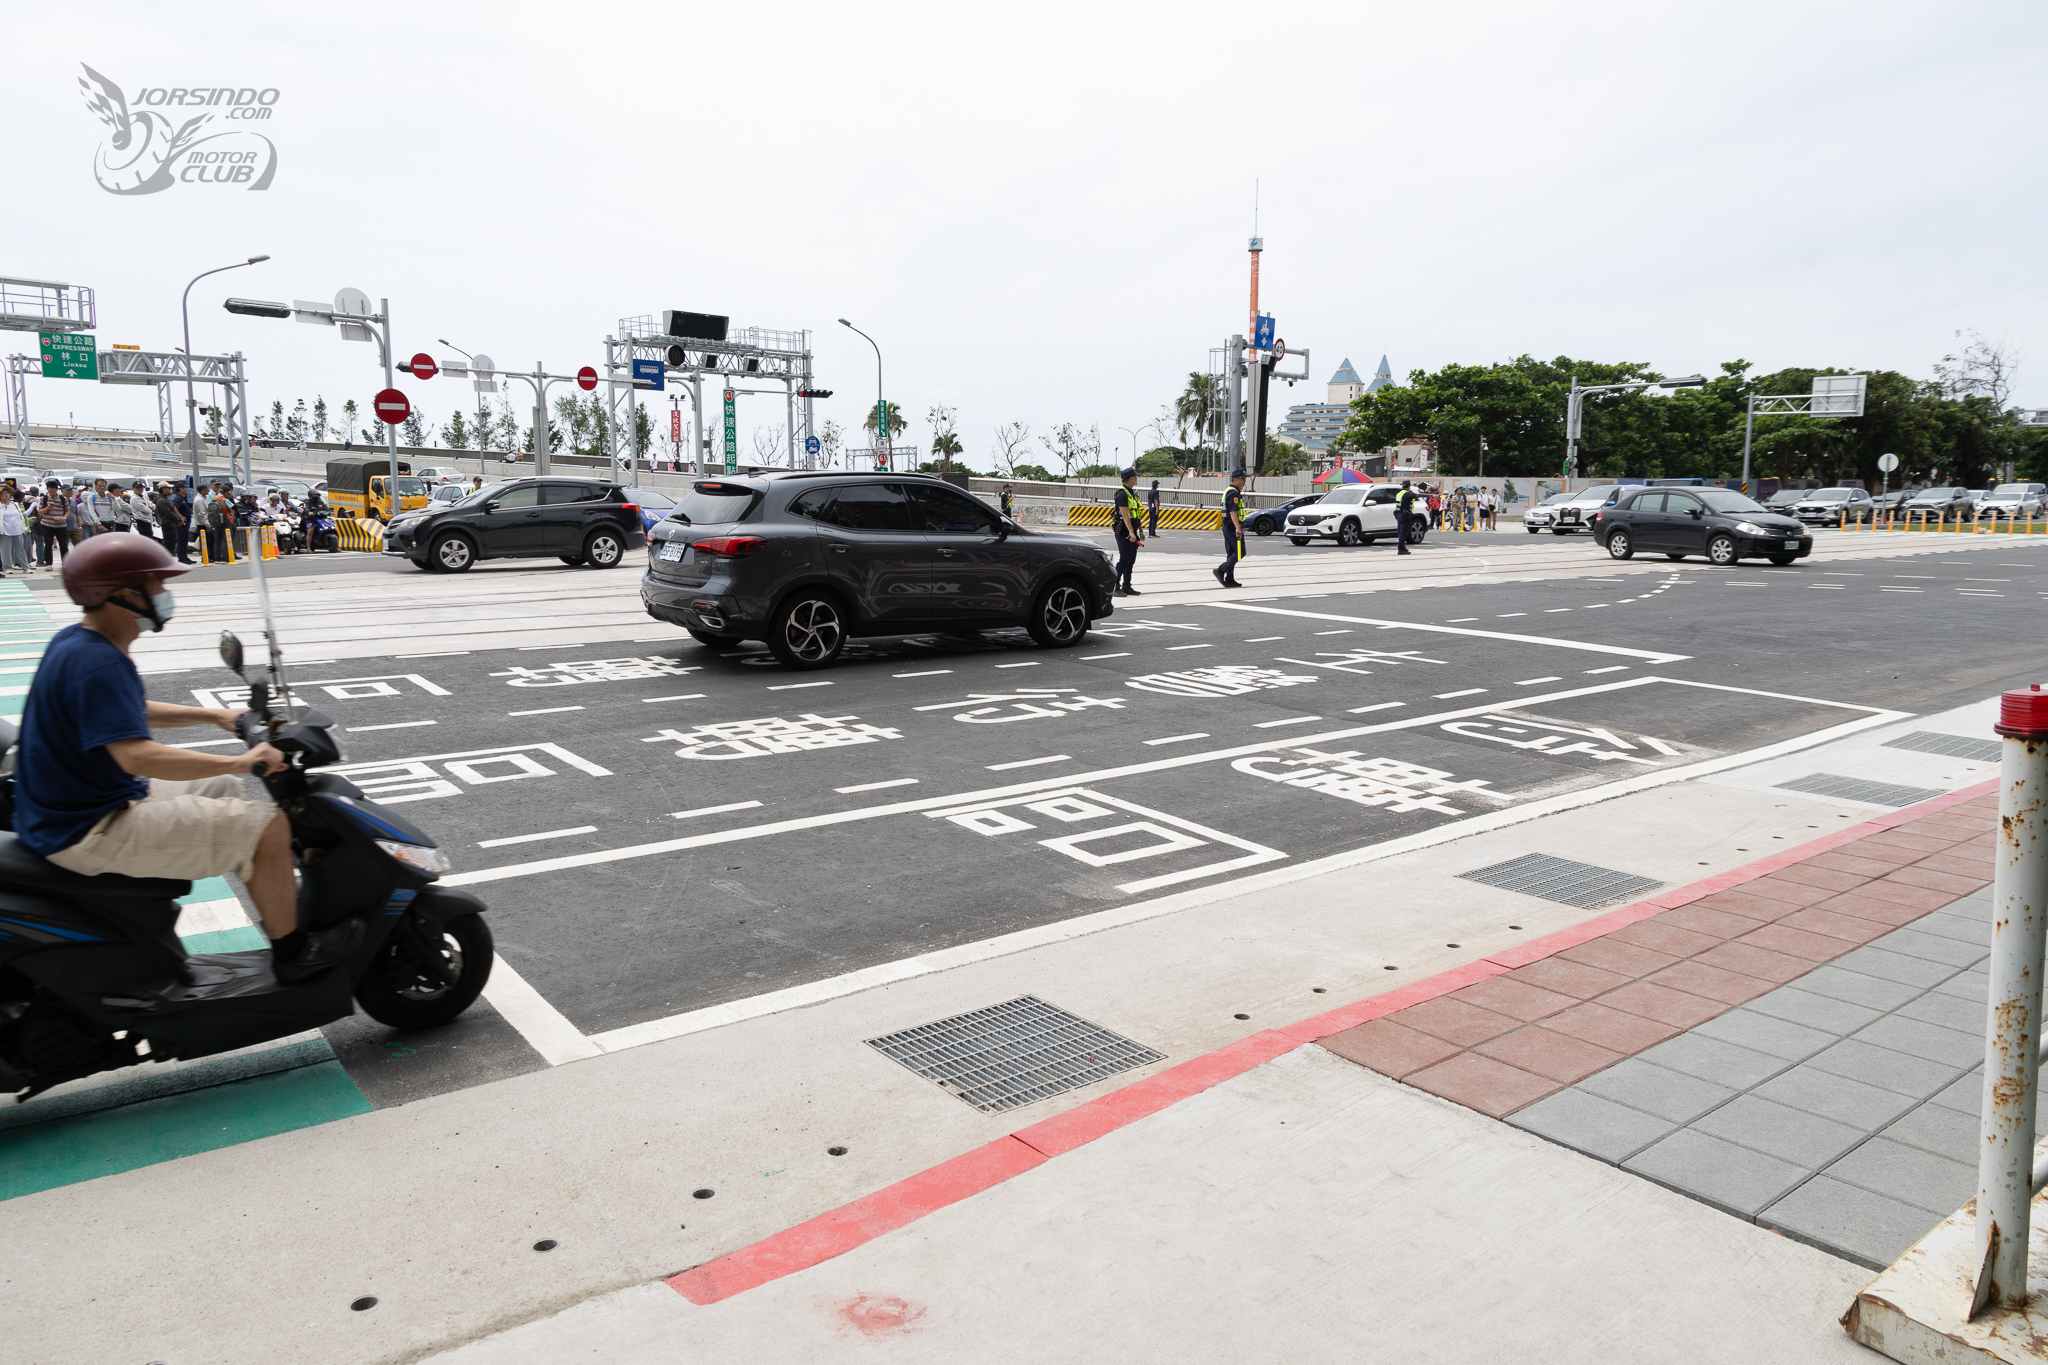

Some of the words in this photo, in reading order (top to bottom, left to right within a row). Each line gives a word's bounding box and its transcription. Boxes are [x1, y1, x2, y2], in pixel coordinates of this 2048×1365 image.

[52, 334, 93, 346] 快速公路
[52, 344, 94, 352] EXPRESSWAY
[61, 352, 88, 361] 林口
[671, 350, 680, 362] 80
